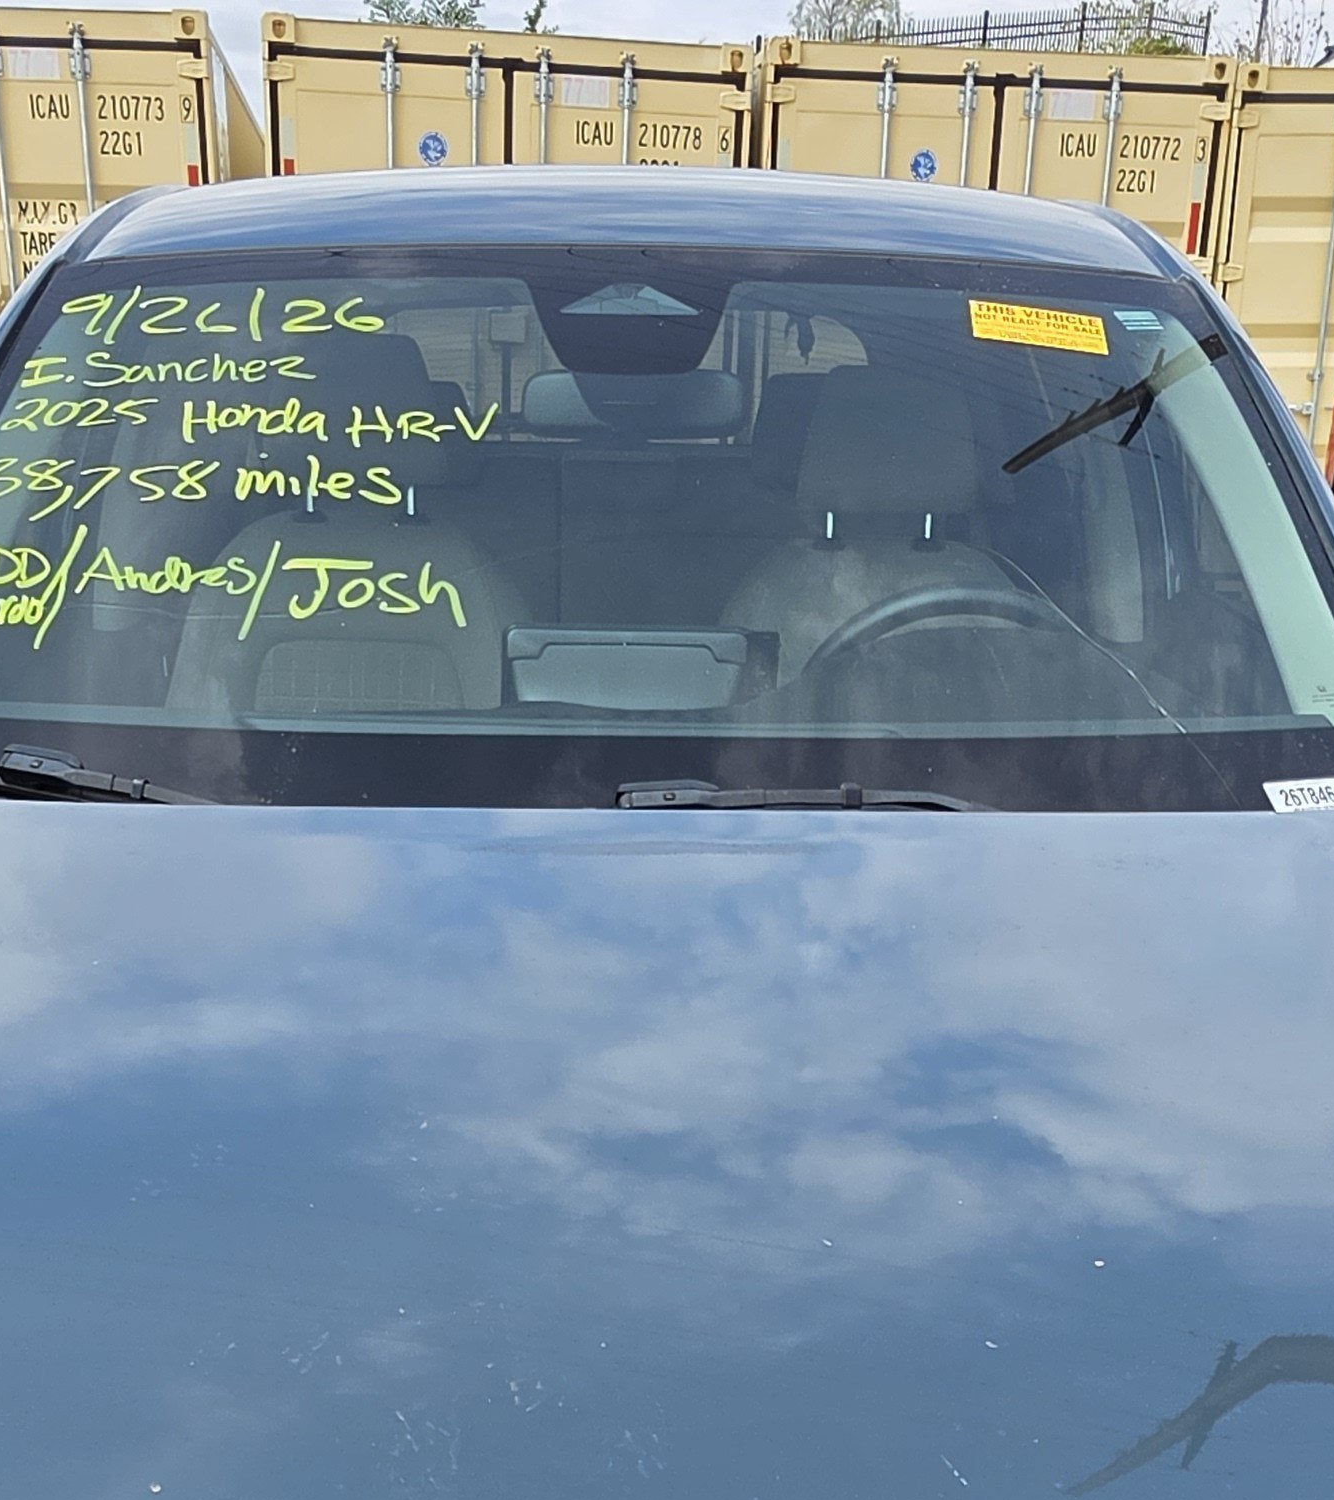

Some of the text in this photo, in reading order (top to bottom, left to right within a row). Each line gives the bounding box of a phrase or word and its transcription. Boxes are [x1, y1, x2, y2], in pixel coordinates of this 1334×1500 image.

[29, 93, 70, 119] ICAU
[97, 94, 165, 121] 210773
[99, 130, 143, 156] 22G1
[576, 120, 614, 146] ICAU
[638, 123, 702, 150] 210778
[1060, 133, 1097, 157] ICAU
[1119, 135, 1181, 161] 210772
[1116, 168, 1155, 193] 22G1
[62, 285, 385, 344] 9/26/26
[974, 312, 997, 321] NOT
[1002, 316, 1040, 326] READY
[1046, 322, 1068, 331] FOR
[1073, 326, 1102, 336] SALE
[975, 303, 1099, 328] THIS VEHICLE
[81, 350, 319, 386] Sanchez
[0, 397, 501, 448] 2025 Honda HR-V
